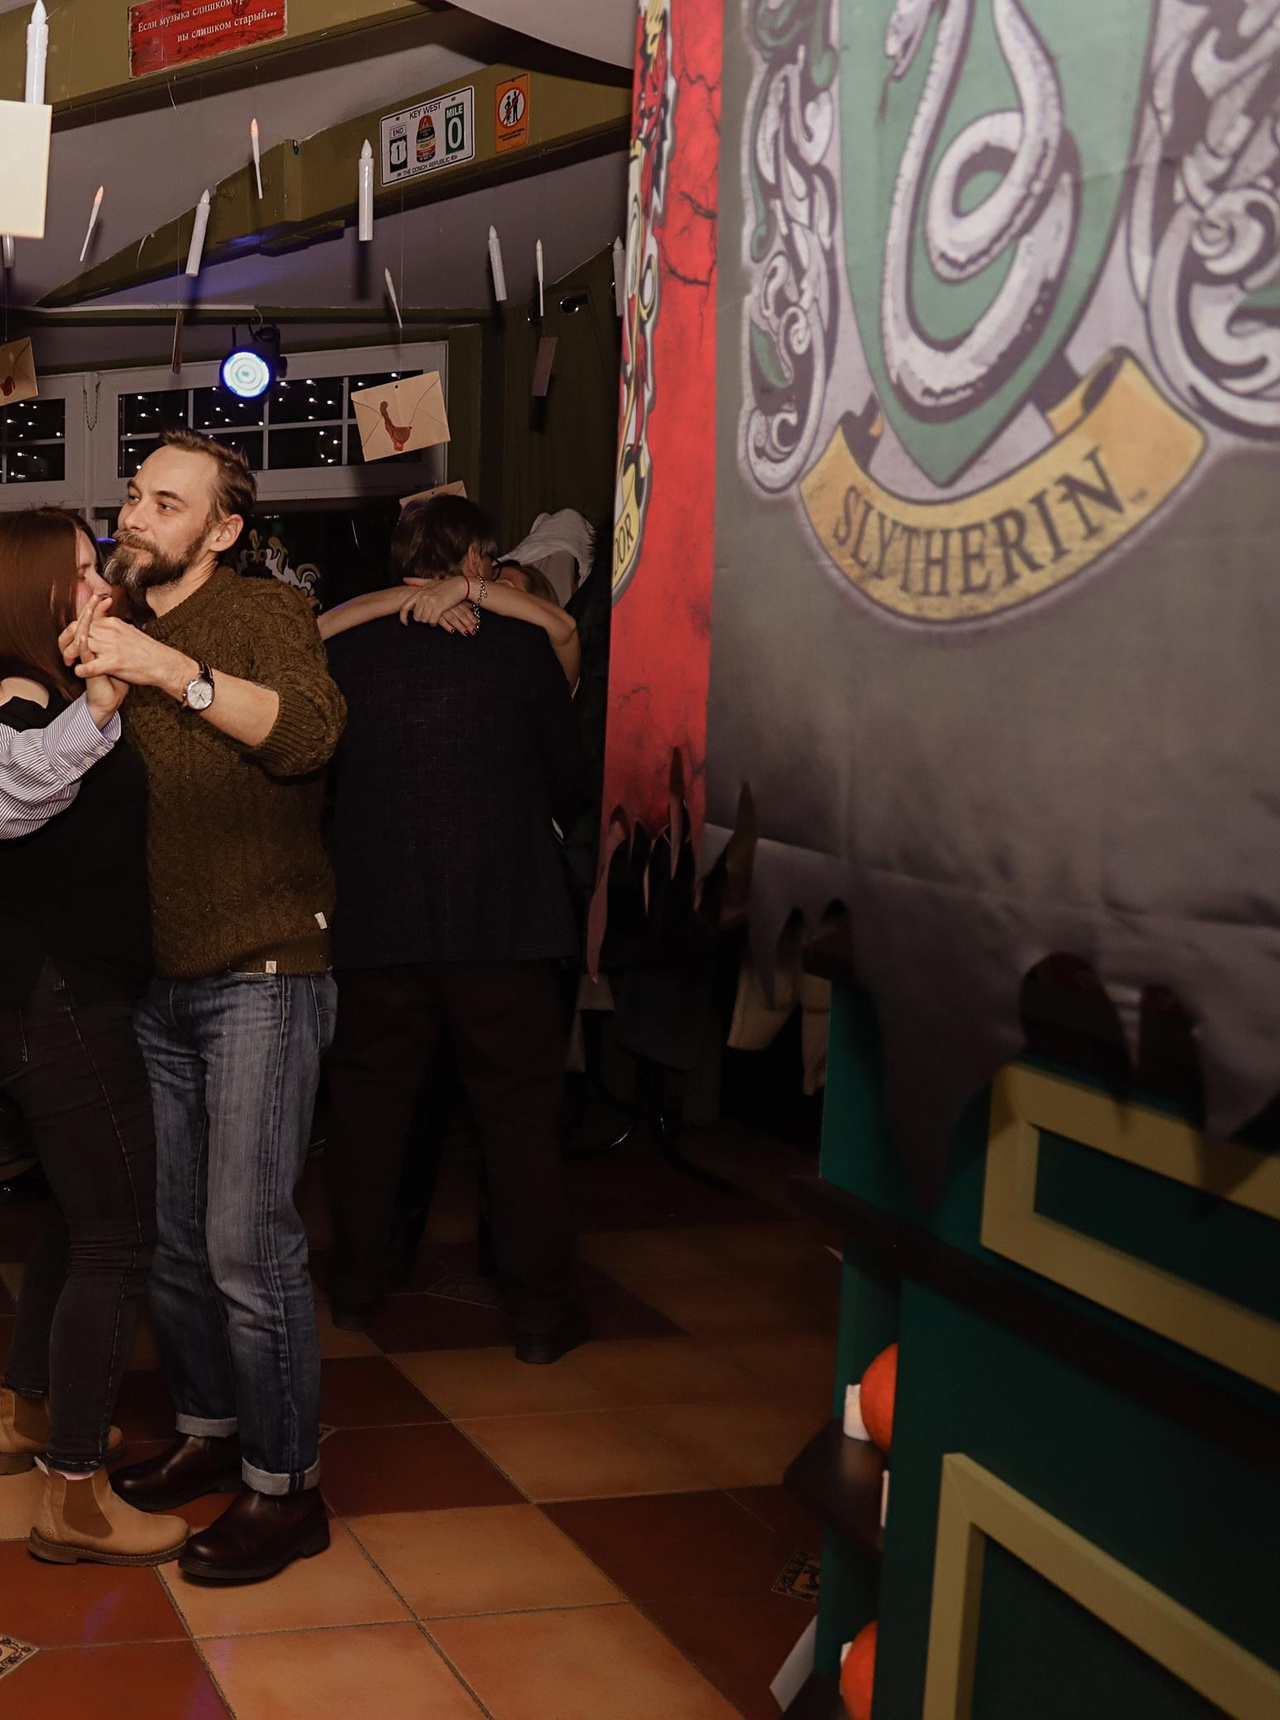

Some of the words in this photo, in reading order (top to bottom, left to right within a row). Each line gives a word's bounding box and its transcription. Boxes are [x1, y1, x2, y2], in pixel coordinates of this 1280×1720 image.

[138, 22, 157, 33] Если
[159, 11, 190, 27] музыка
[192, 0, 233, 16] слишком
[177, 33, 189, 43] вы
[191, 21, 232, 38] слишком
[234, 8, 277, 29] старый...
[409, 109, 422, 119] KEY
[423, 102, 442, 114] WEST
[446, 104, 464, 119] MILE
[392, 127, 404, 137] END
[447, 117, 462, 149] 0
[396, 145, 400, 161] 1
[832, 445, 1124, 597] SLYTHERIN
